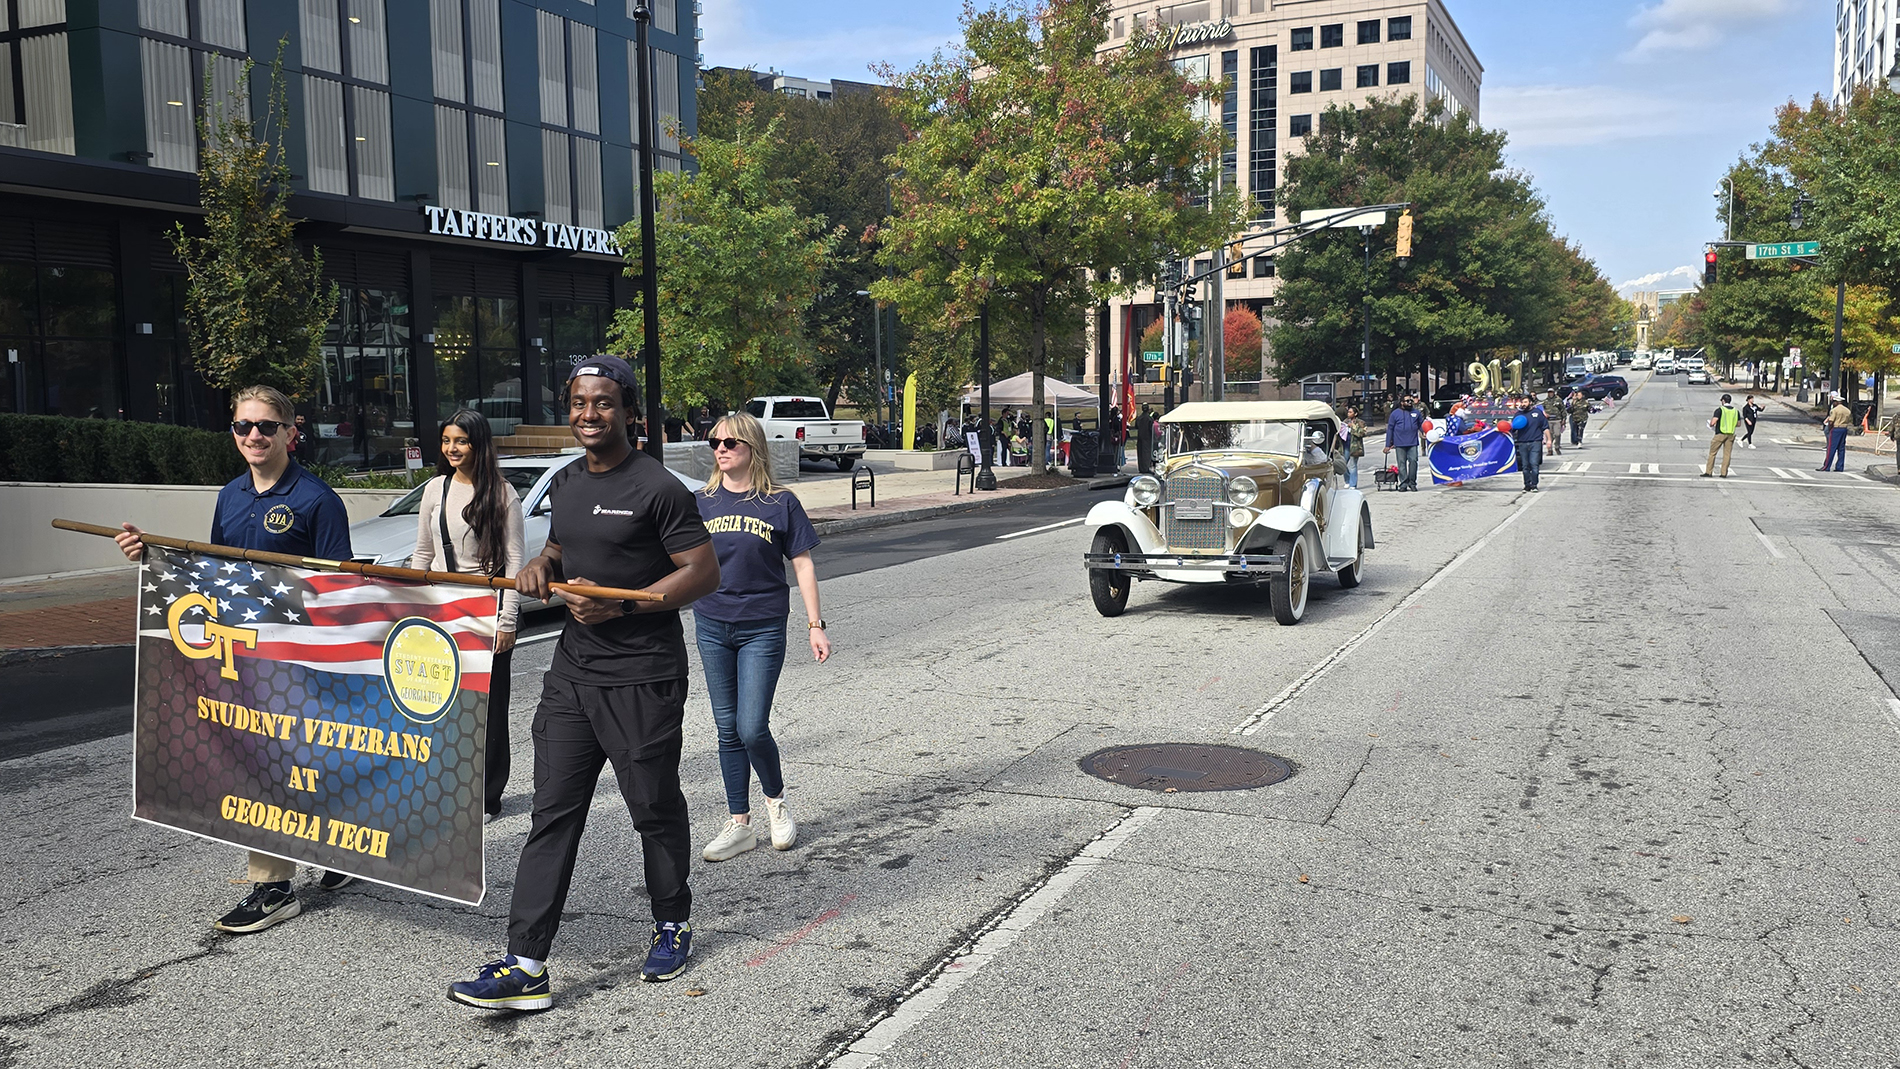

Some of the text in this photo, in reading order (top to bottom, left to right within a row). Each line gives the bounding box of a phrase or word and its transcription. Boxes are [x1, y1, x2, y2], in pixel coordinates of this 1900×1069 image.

[425, 205, 623, 256] TAFFER'S TAVERN
[1758, 246, 1778, 256] 17th
[1781, 245, 1791, 255] St
[1468, 358, 1524, 397] 911
[269, 513, 286, 526] SVA
[703, 515, 742, 534] ORGIA
[167, 592, 258, 682] GT
[394, 658, 452, 682] SVAGT
[197, 695, 432, 763] STUDENT VETERANS
[288, 765, 319, 793] AT
[220, 794, 390, 858] GEORGIA TECH
